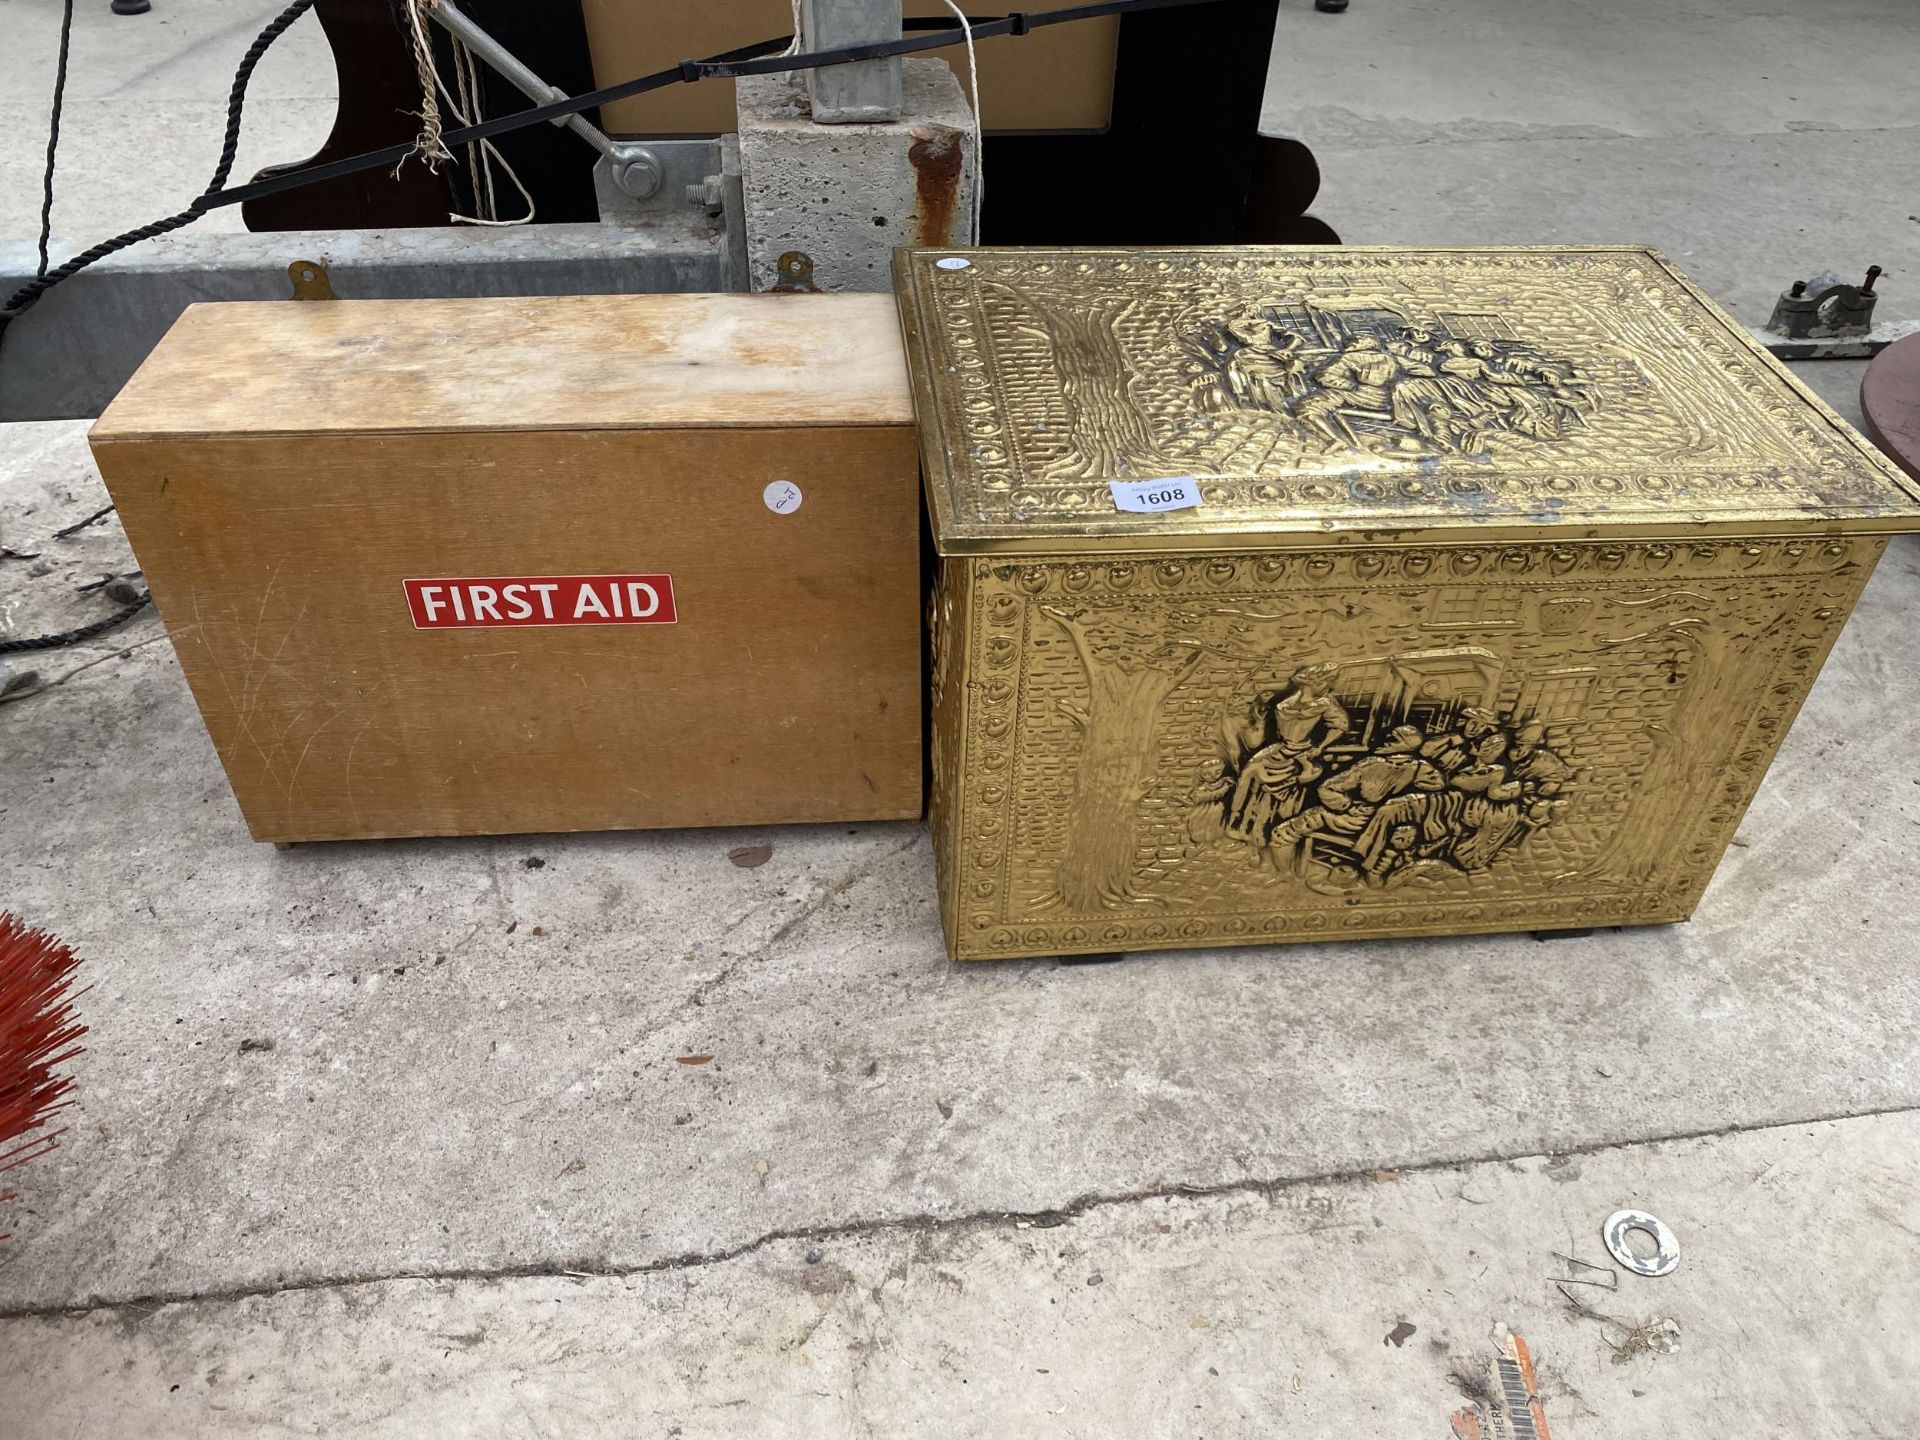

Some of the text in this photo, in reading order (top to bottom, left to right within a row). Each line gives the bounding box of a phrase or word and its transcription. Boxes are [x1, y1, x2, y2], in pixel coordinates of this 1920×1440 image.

[1136, 488, 1185, 505] 1608
[420, 582, 659, 621] FIRST AID
